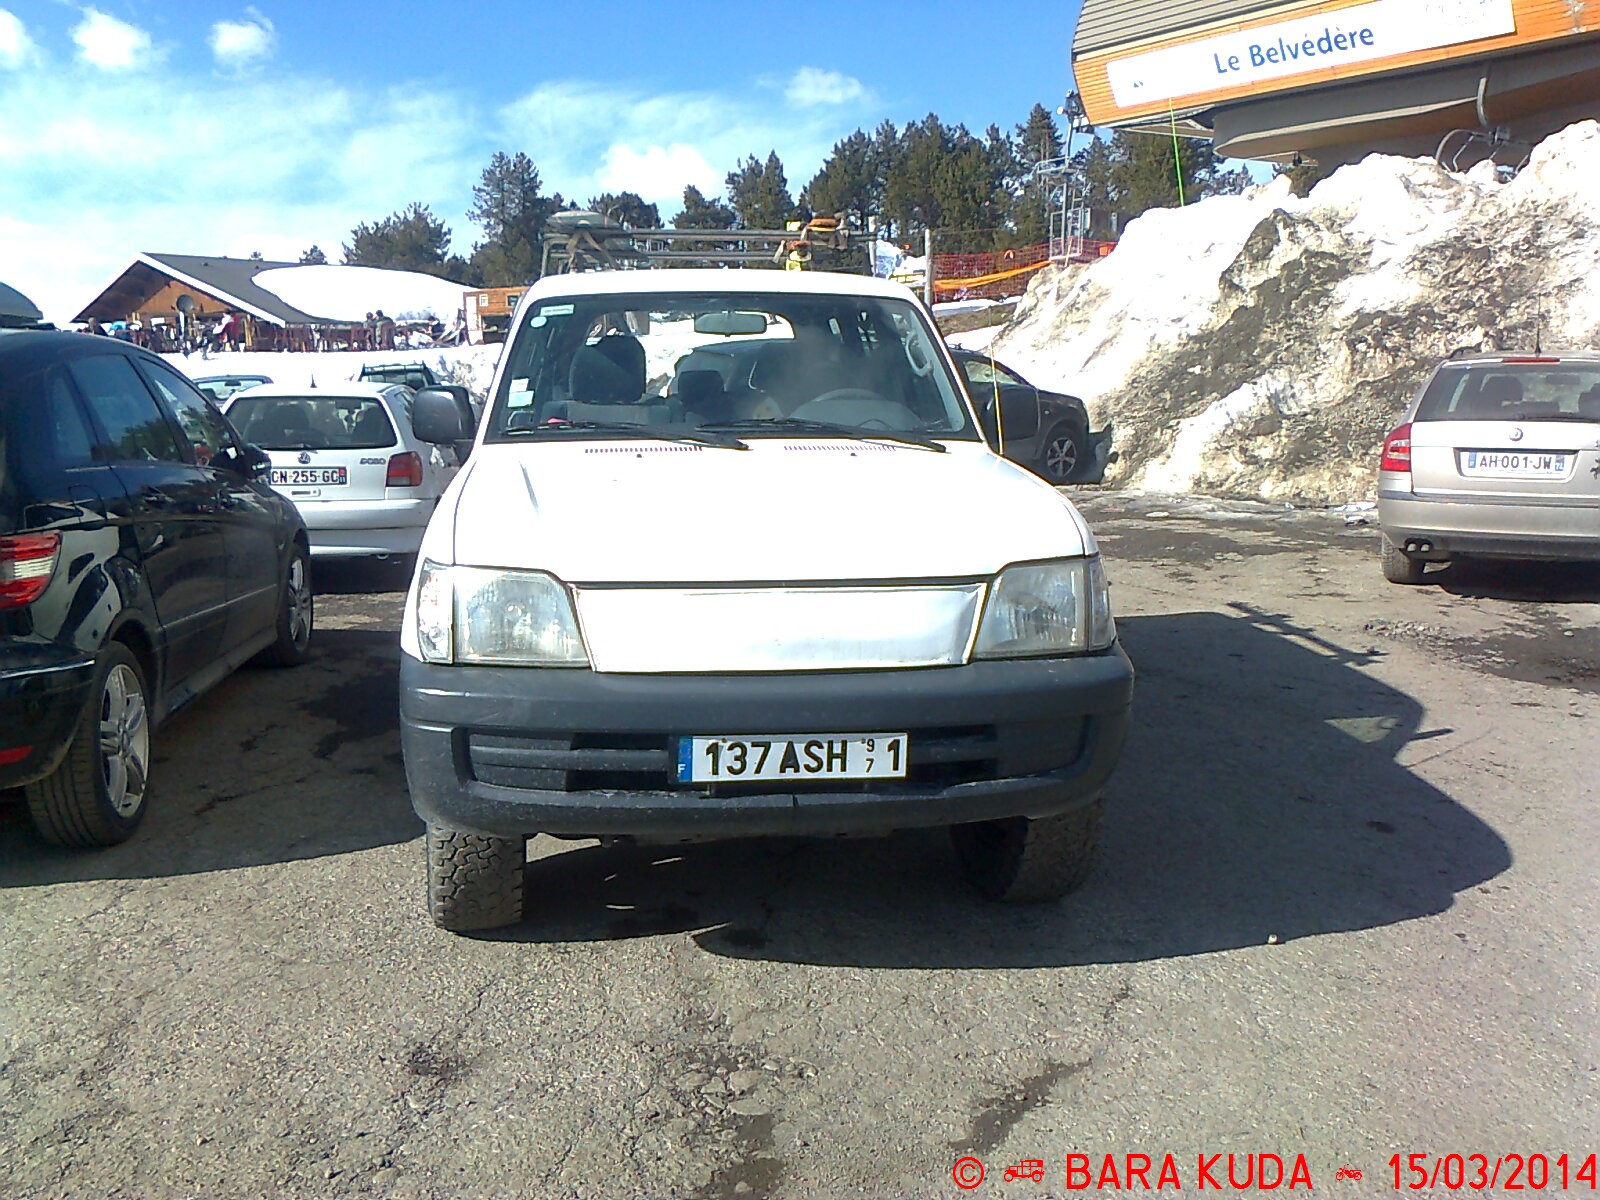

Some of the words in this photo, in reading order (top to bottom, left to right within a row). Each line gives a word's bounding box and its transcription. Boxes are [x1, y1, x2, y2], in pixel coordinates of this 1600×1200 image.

[1214, 53, 1240, 74] Le
[1249, 27, 1374, 67] Belvédère
[677, 763, 686, 774] F
[706, 741, 771, 776] 137
[779, 739, 848, 774] ASH
